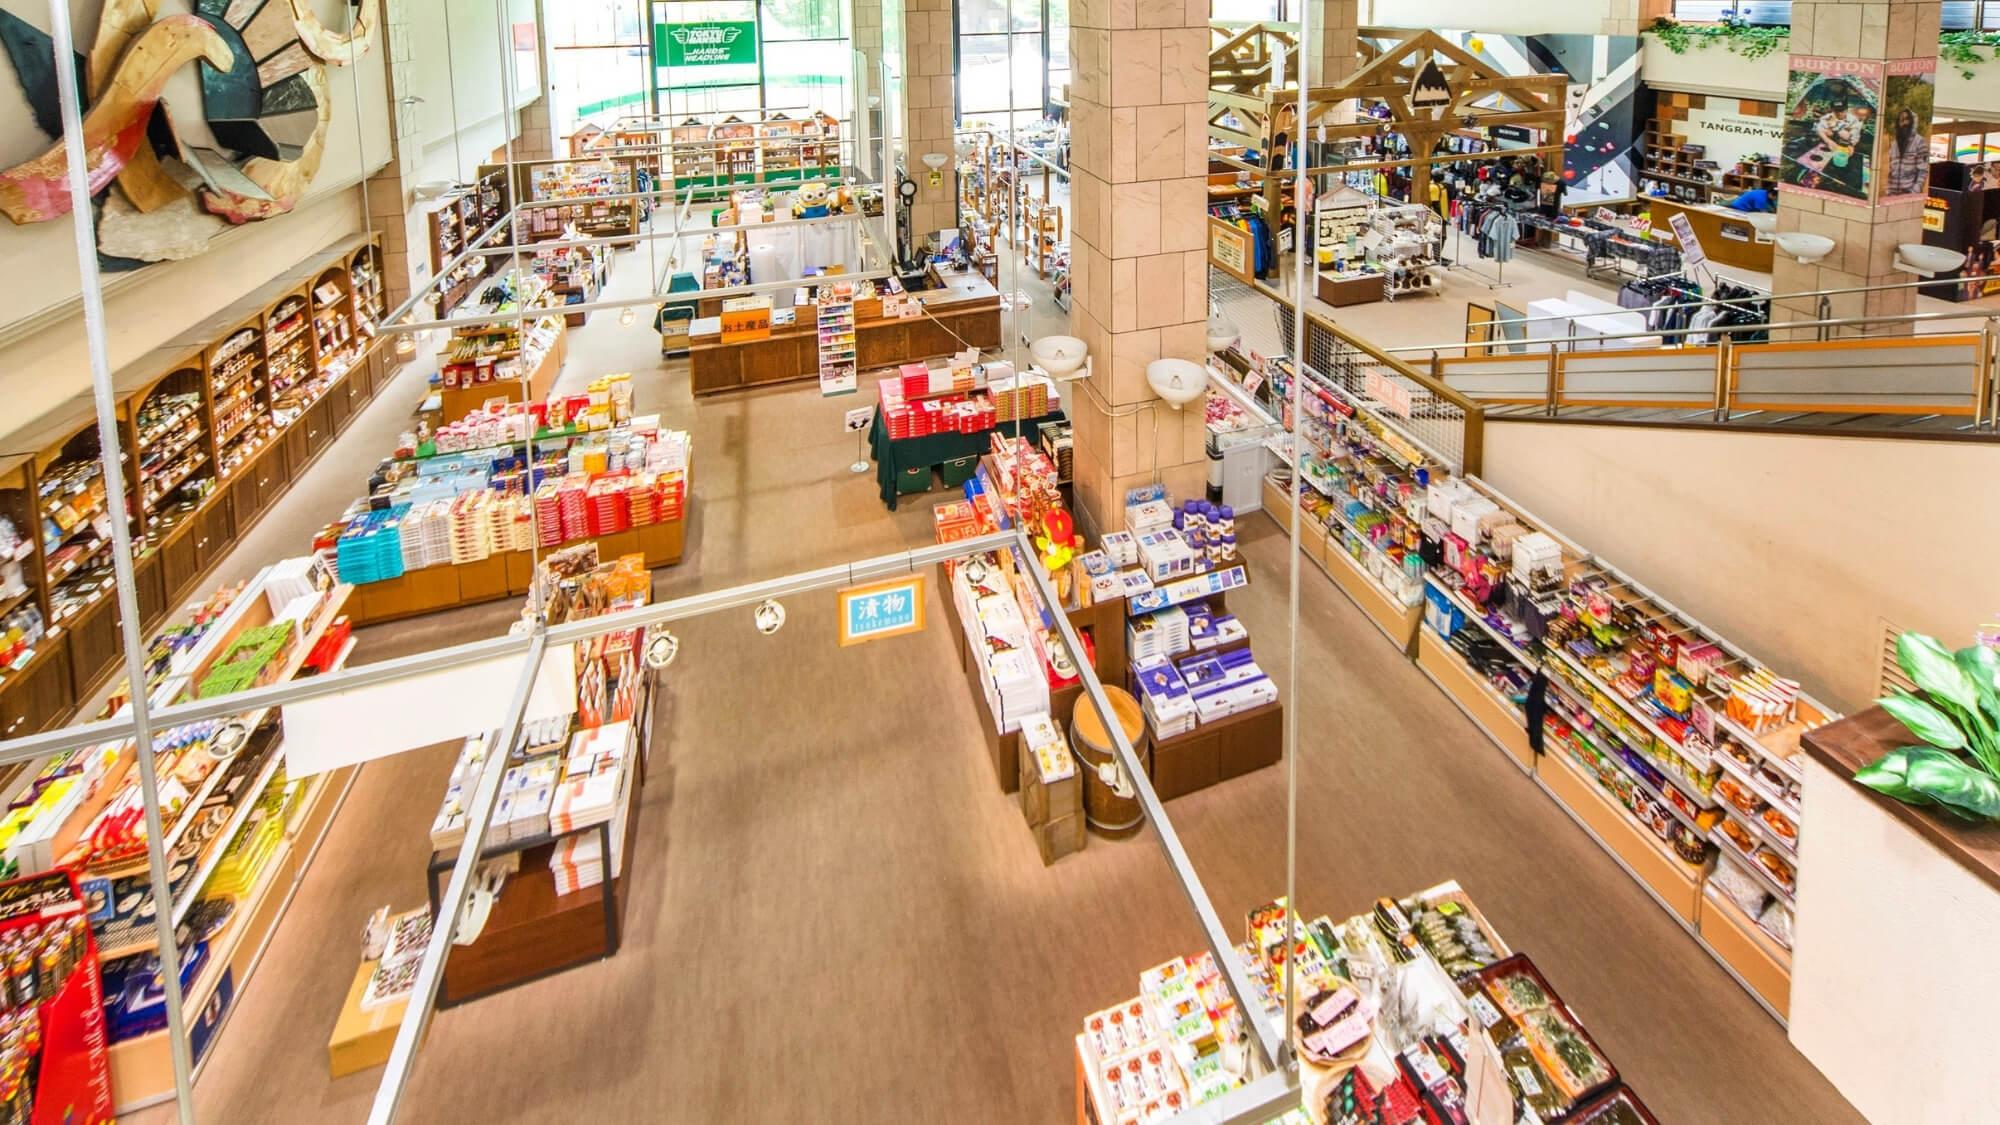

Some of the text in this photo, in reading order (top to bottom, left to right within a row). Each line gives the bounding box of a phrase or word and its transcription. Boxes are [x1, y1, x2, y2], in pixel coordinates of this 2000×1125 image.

[689, 29, 723, 38] TOKYU
[684, 53, 731, 62] HEADLINE
[692, 47, 730, 55] HANDS
[1794, 57, 1876, 74] BURTON
[1890, 60, 1934, 73] BURTON
[722, 319, 769, 333] お土産品
[858, 594, 905, 620] 漬物
[80, 959, 102, 1026] Chocolate
